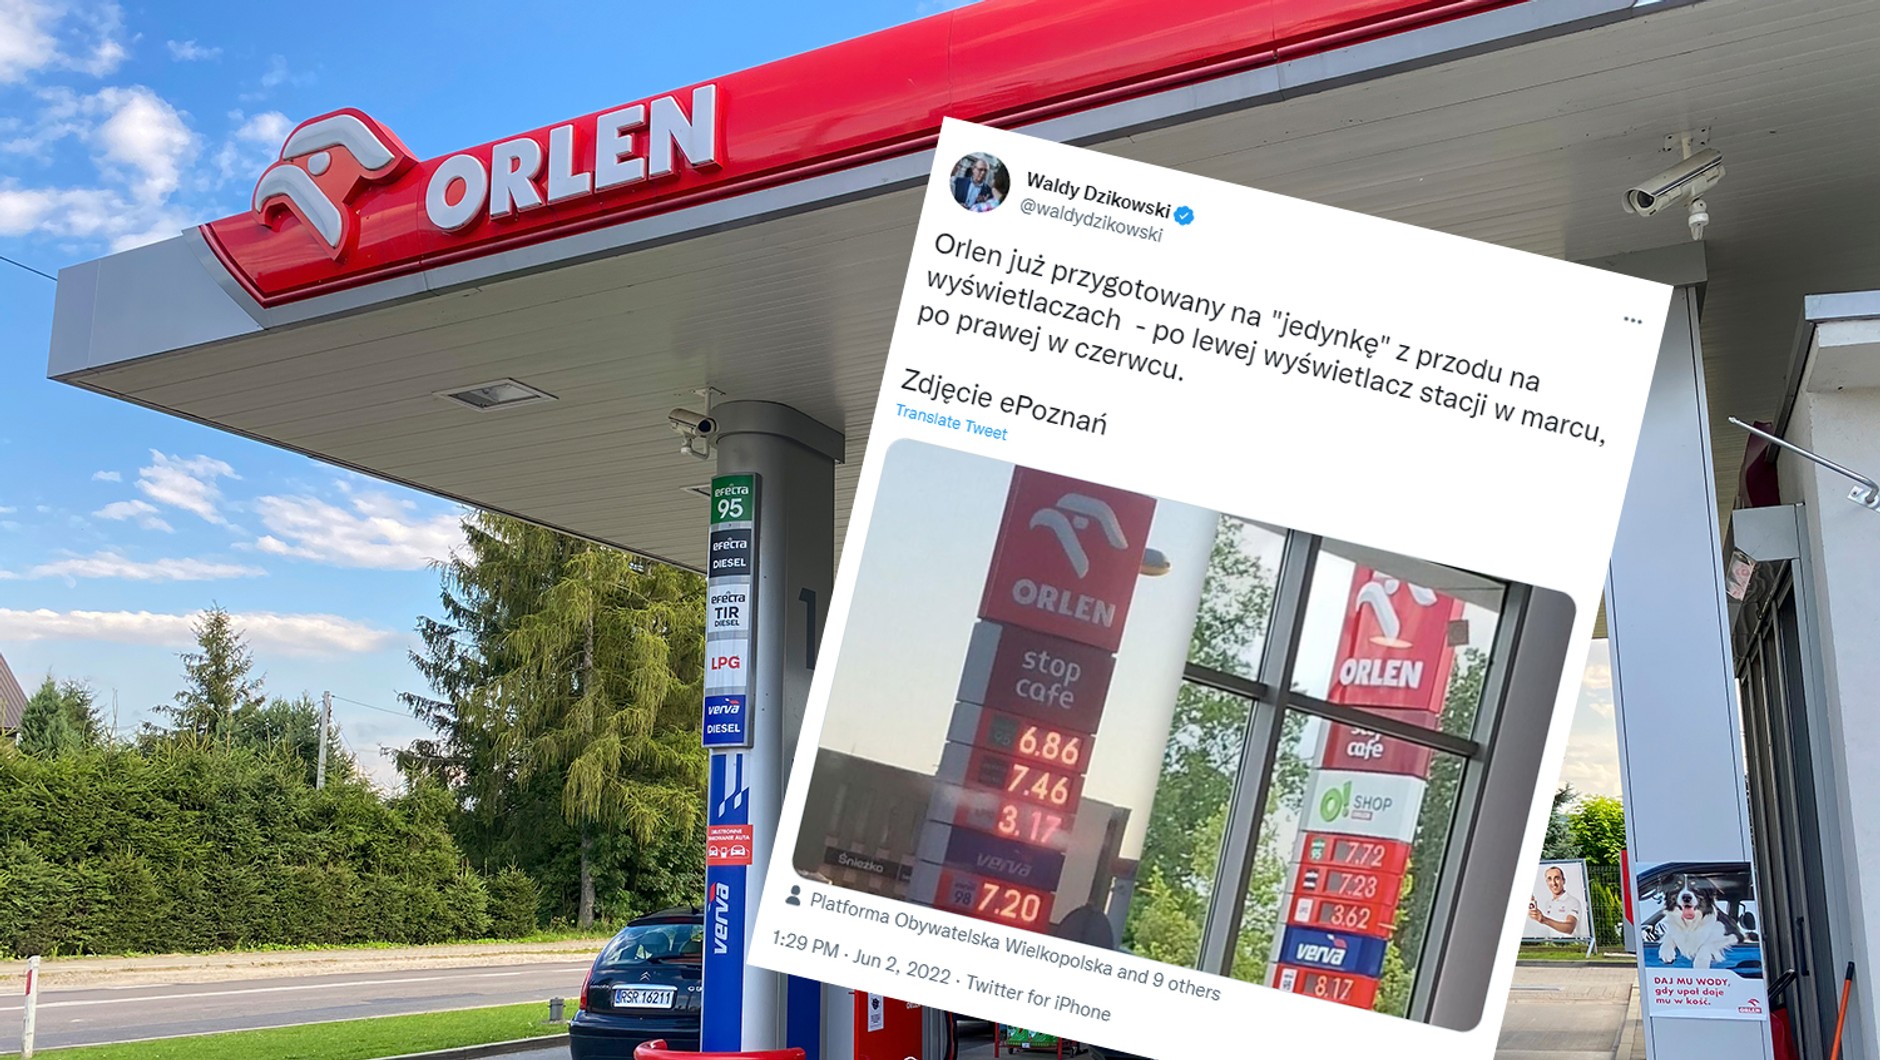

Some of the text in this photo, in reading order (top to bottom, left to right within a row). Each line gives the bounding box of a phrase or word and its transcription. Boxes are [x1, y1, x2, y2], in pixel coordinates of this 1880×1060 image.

[426, 84, 716, 231] ORLEN
[714, 485, 749, 498] efecta
[717, 498, 743, 519] 95
[712, 539, 748, 552] efecta
[712, 558, 746, 569] DIESEL
[711, 593, 745, 605] efecta
[1012, 578, 1116, 628] ORLEN
[714, 606, 739, 619] TIR
[714, 619, 740, 628] DIESEL
[711, 656, 741, 670] LPG
[1022, 650, 1081, 683] stop
[1339, 658, 1423, 690] ORLEN
[1016, 678, 1075, 710] cafe
[708, 703, 740, 716] verva
[707, 723, 741, 734] DIESEL
[1018, 726, 1080, 766] 6.86
[1346, 739, 1384, 760] cafe
[1007, 764, 1069, 804] 7.46
[1353, 794, 1393, 812] SHOP
[998, 804, 1062, 844] 3.17
[976, 852, 1033, 878] verva
[1344, 841, 1386, 867] 7.72
[1337, 872, 1378, 898] 7.23
[954, 882, 1041, 923] 98 7.20
[714, 883, 730, 955] verva
[1331, 903, 1371, 930] 3.62
[1296, 942, 1346, 965] verva
[1314, 975, 1354, 1001] 8.17
[1654, 977, 1731, 987] DAJ MU WODY,
[1655, 987, 1674, 996] gdy
[1702, 988, 1725, 997] daje
[621, 990, 672, 1004] RSR 16211
